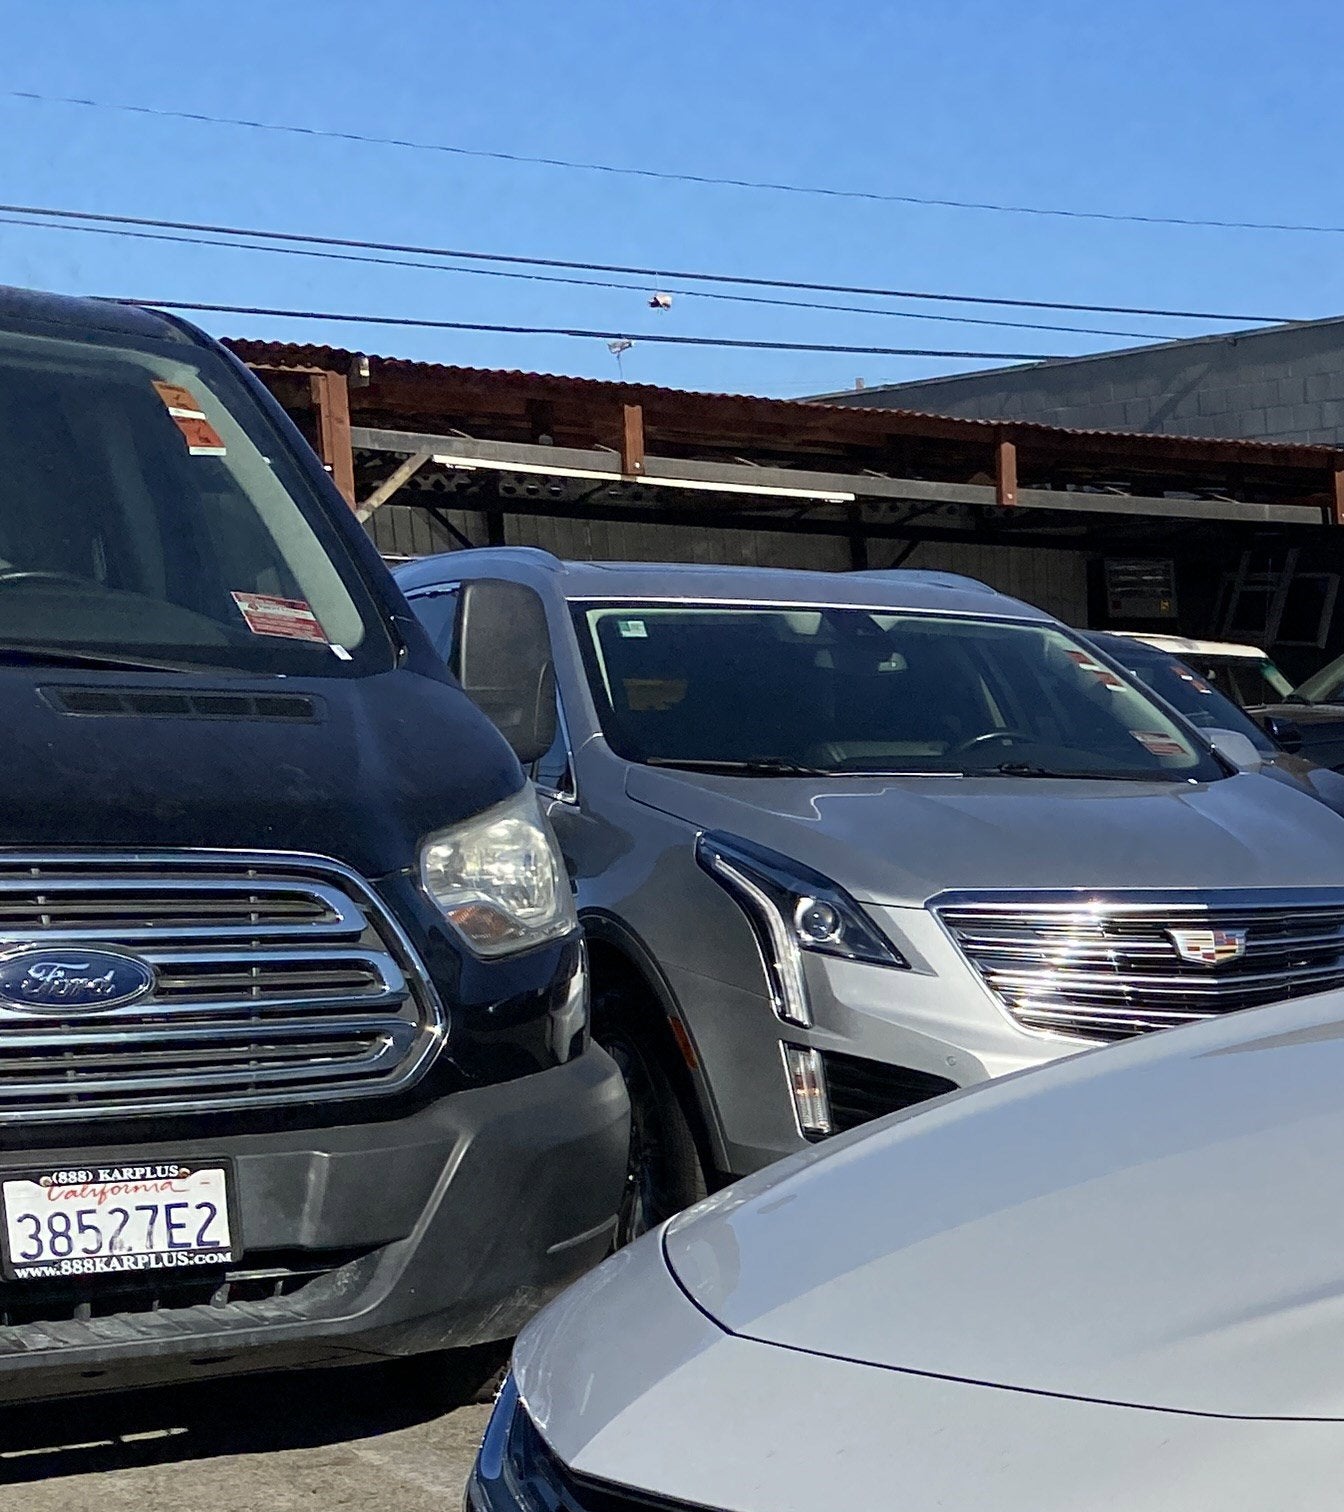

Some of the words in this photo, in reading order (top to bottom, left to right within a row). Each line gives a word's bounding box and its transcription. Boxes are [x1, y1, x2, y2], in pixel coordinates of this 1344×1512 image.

[22, 962, 116, 996] Ford
[52, 1169, 94, 1184] (888)
[97, 1165, 179, 1181] KARPLUS
[47, 1180, 190, 1206] California
[16, 1202, 221, 1261] 38527E2
